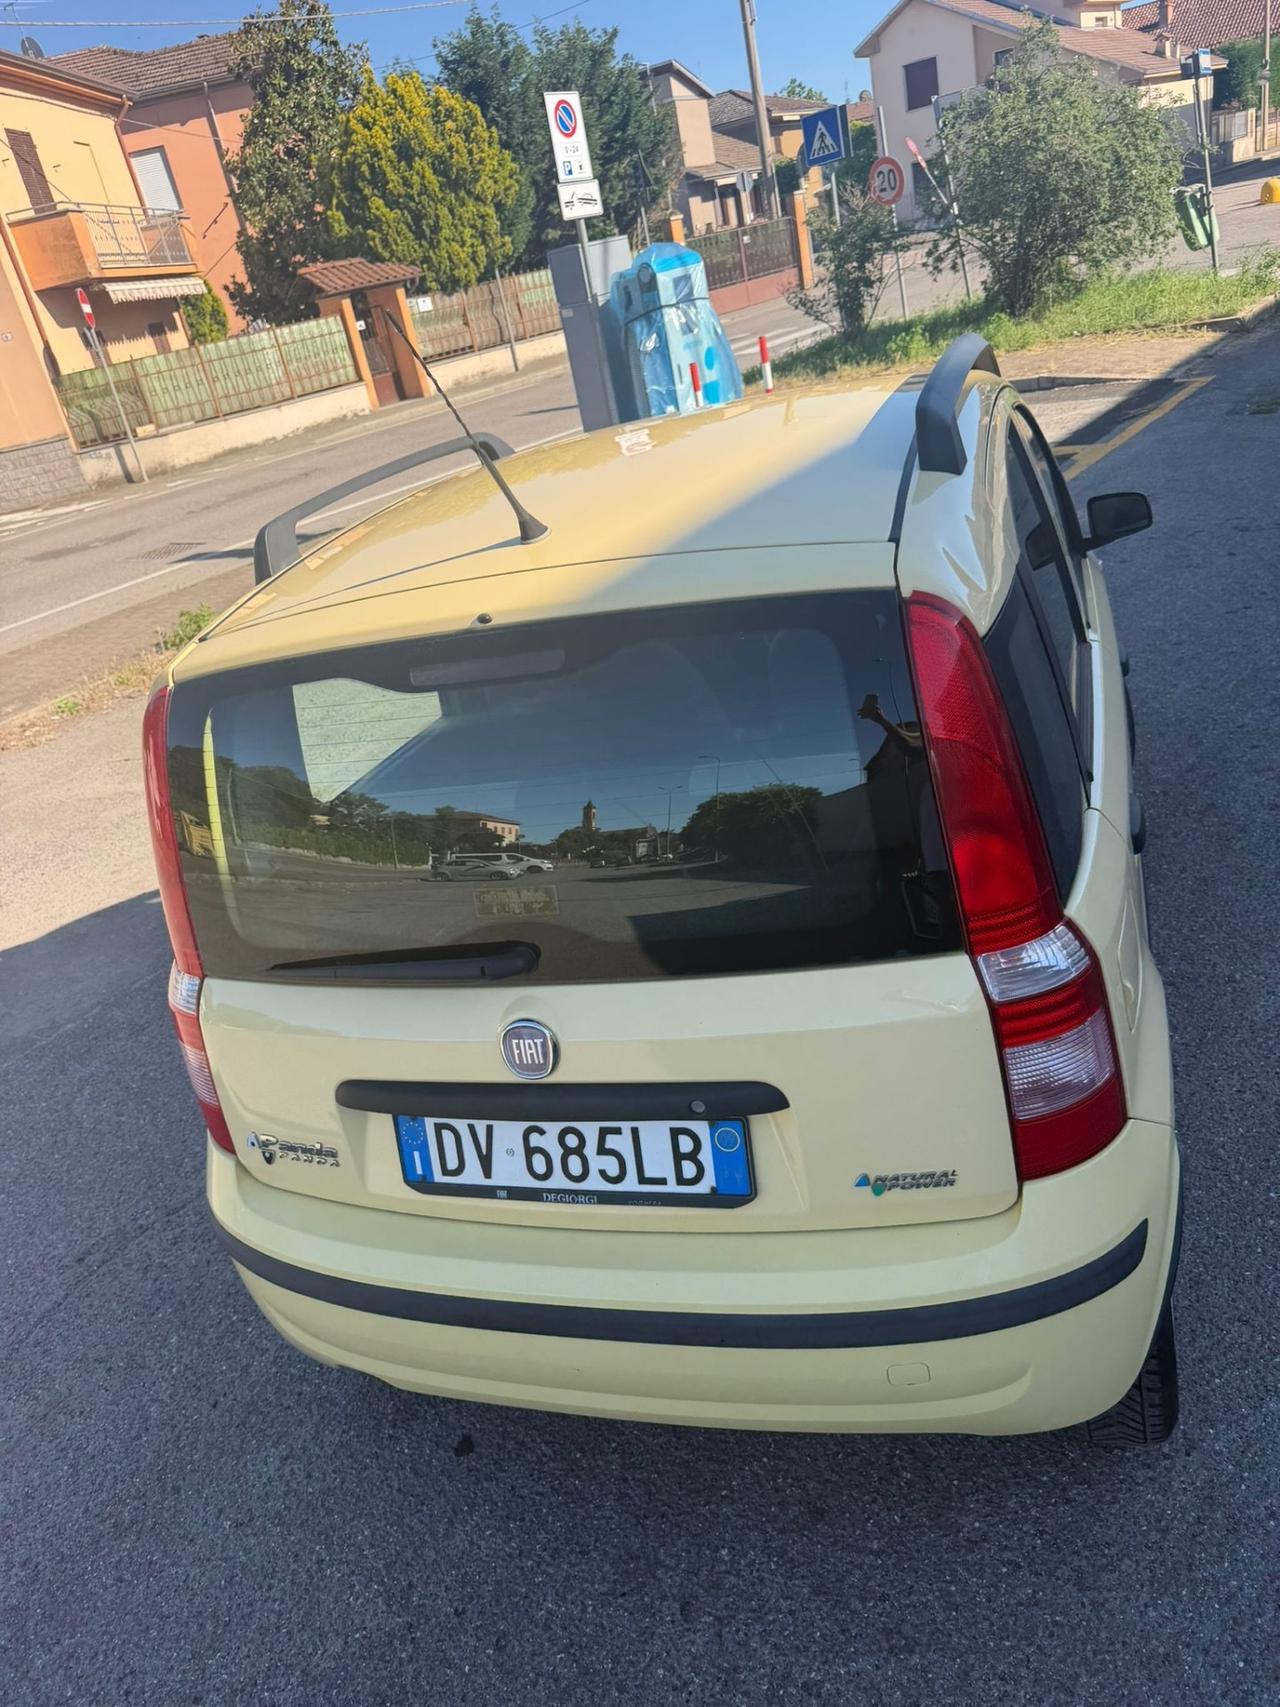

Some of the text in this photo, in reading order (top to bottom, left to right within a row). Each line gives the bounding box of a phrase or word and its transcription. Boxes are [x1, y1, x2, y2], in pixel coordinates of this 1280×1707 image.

[877, 168, 897, 193] 20
[512, 1038, 544, 1065] FIAT
[258, 1133, 338, 1159] Panda
[433, 1122, 706, 1187] DV 685LB
[873, 1169, 959, 1185] NATURAL
[886, 1178, 957, 1192] POWER
[543, 1192, 598, 1205] DEGIORGI
